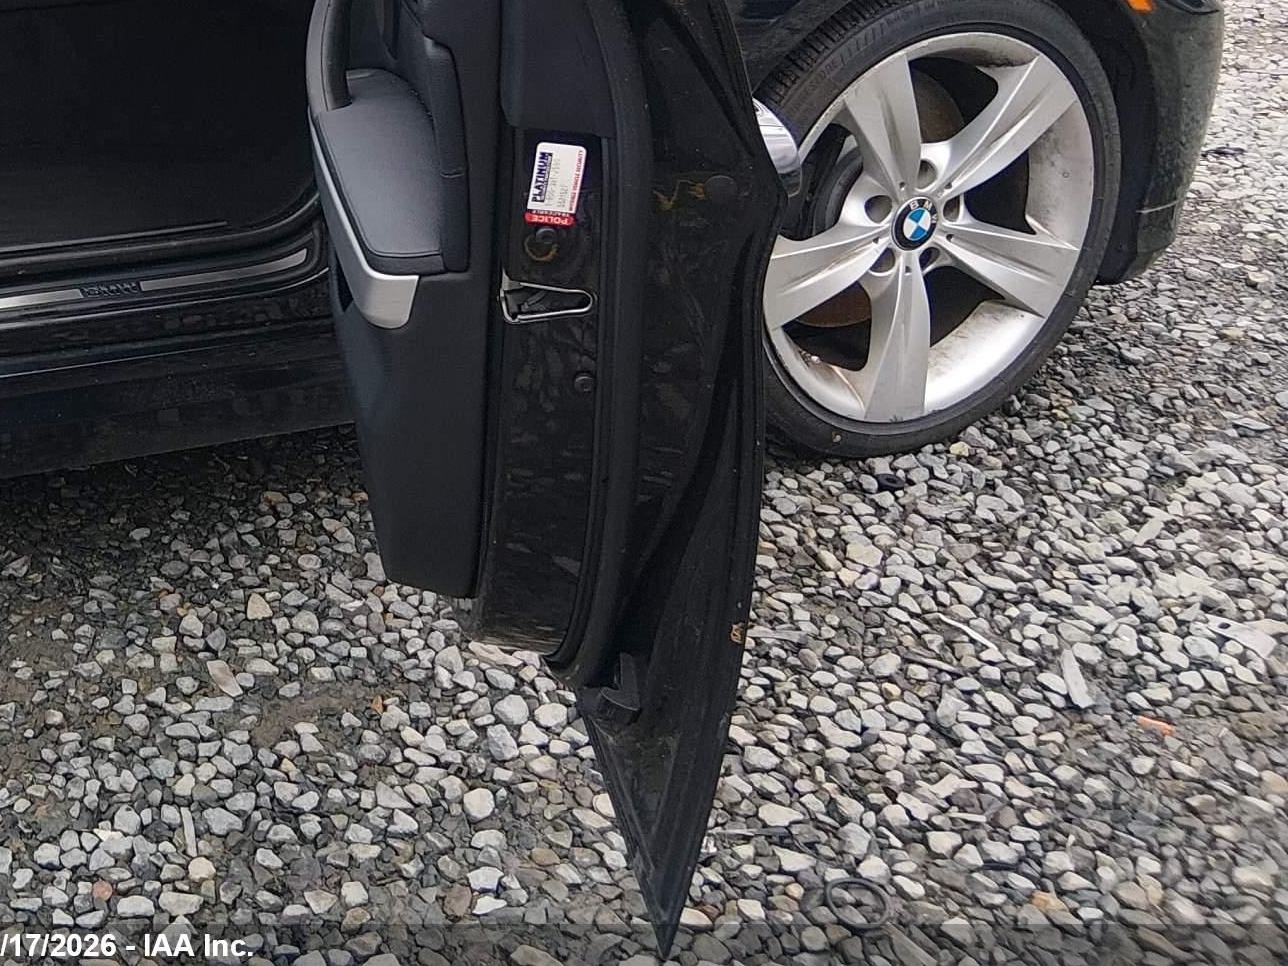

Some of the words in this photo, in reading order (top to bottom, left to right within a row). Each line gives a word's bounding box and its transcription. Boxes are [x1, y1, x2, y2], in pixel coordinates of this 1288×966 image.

[531, 151, 550, 203] PLATINUM
[533, 214, 569, 225] POLICE
[909, 200, 937, 224] BMW
